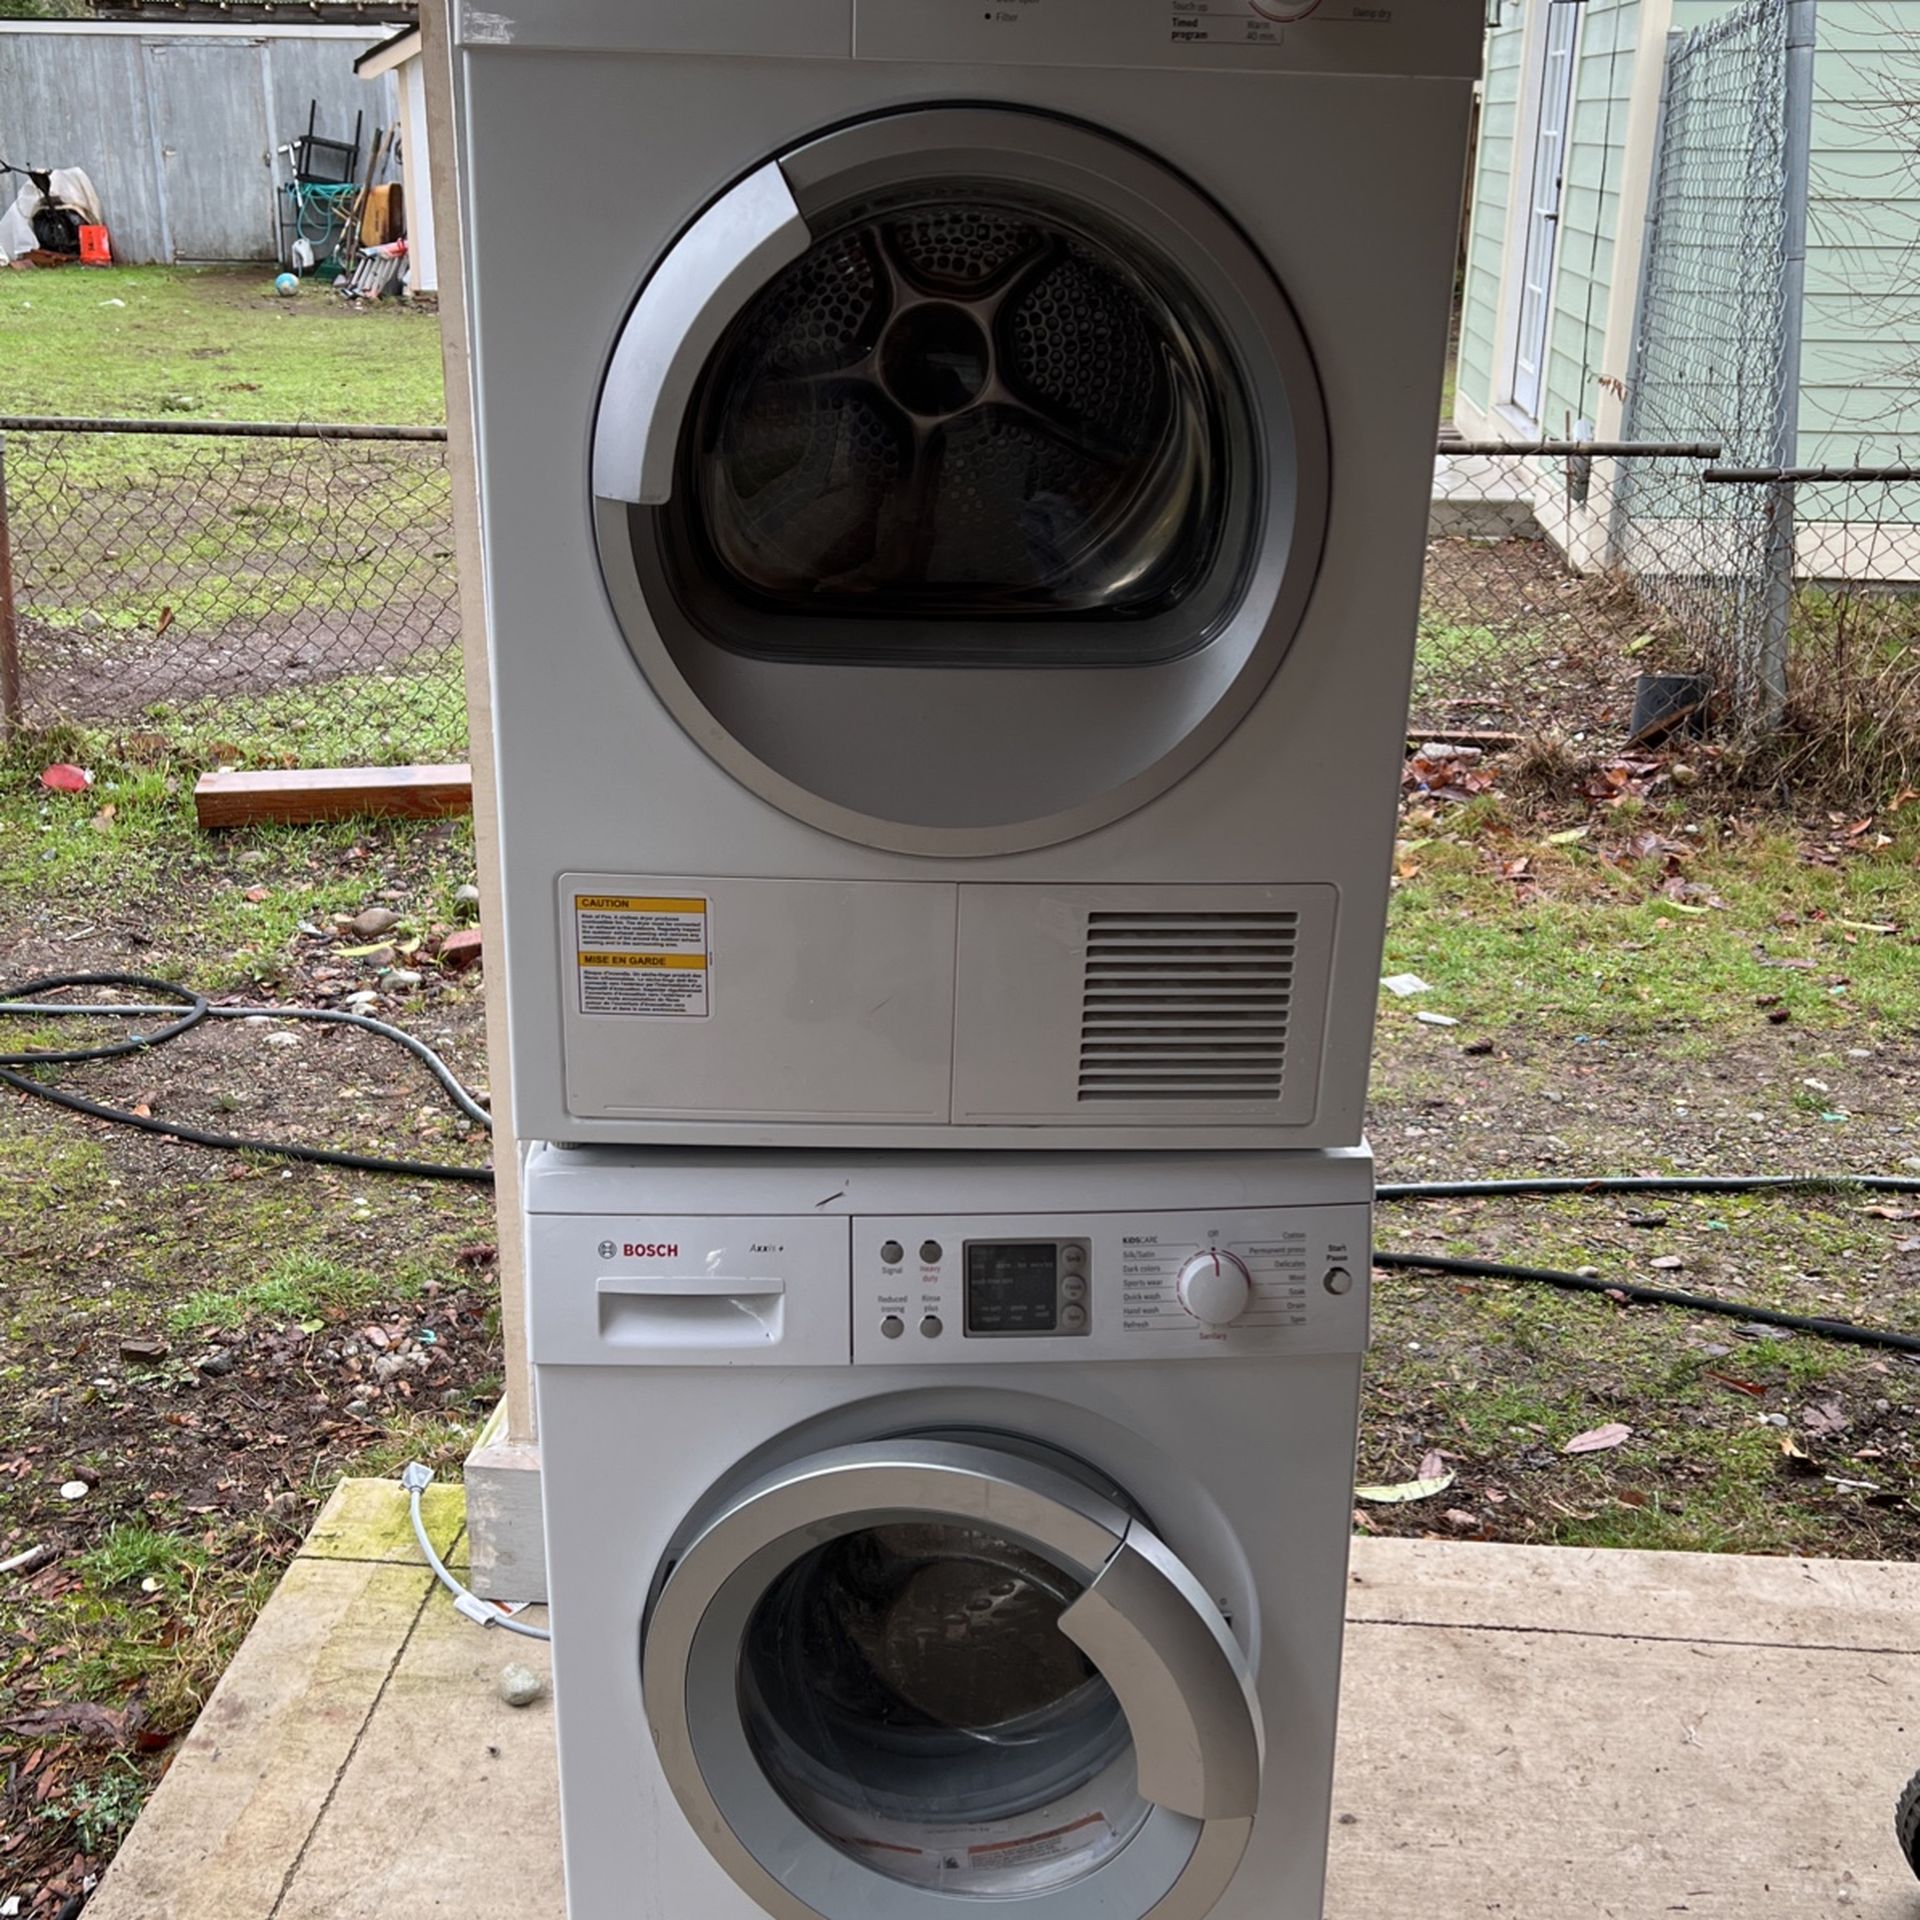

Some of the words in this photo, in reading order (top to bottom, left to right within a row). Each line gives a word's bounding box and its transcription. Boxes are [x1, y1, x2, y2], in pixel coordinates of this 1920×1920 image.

[1172, 18, 1197, 28] Timed
[1171, 30, 1208, 41] program
[582, 899, 629, 908] CAUTION
[584, 955, 609, 965] MISE
[612, 956, 626, 965] EN
[629, 957, 666, 966] GARDE
[1283, 1232, 1306, 1240] Cotton
[623, 1244, 678, 1257] BOSCH
[1328, 1244, 1347, 1252] Start
[1123, 1251, 1155, 1259] Silk/Satin
[1326, 1254, 1348, 1262] Pause
[882, 1267, 903, 1276] Signal
[1123, 1265, 1138, 1273] Dark
[1140, 1265, 1161, 1273] colors
[1123, 1279, 1145, 1288] Sports
[1123, 1293, 1141, 1302] Quick
[1143, 1293, 1161, 1301] wash
[1123, 1307, 1141, 1315] Hand
[1143, 1307, 1160, 1315] wash
[1123, 1321, 1150, 1329] Refresh
